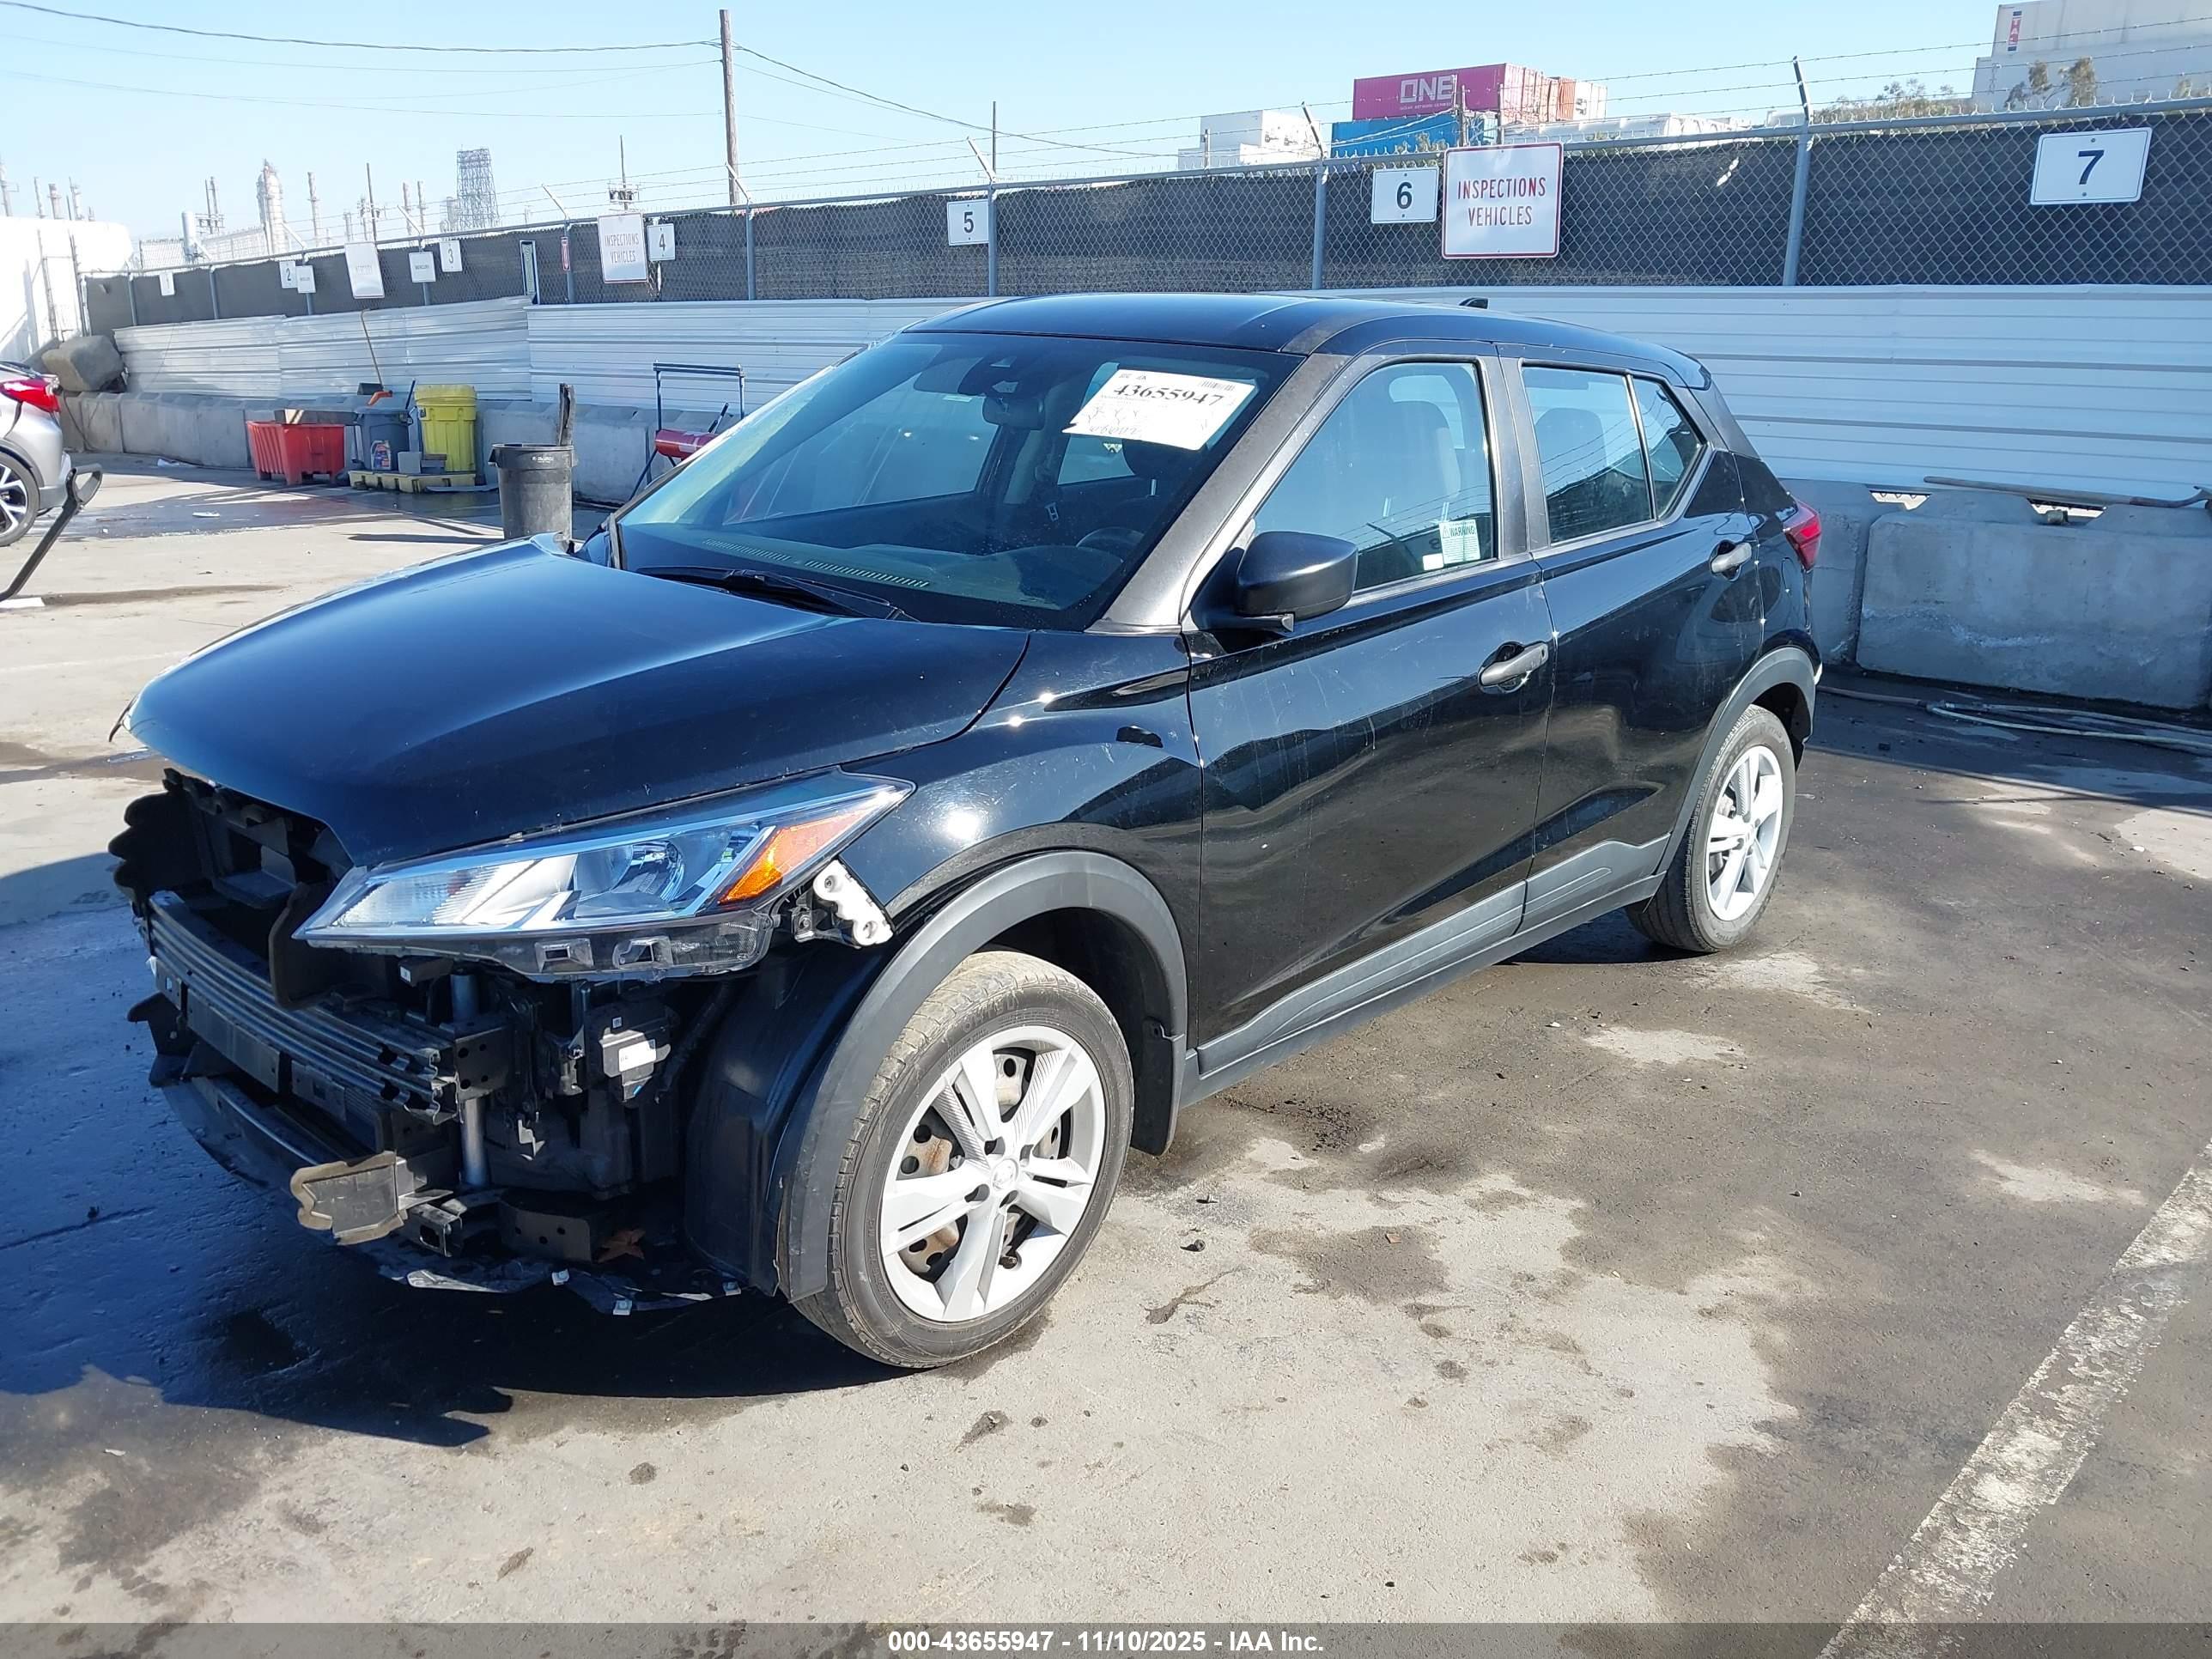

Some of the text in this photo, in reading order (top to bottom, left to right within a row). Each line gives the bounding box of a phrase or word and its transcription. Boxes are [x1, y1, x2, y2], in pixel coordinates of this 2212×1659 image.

[1401, 76, 1454, 103] ONE
[2078, 149, 2105, 185] 7
[1396, 181, 1413, 210] 6
[1457, 177, 1547, 200] INSPECTIONS
[963, 211, 974, 234] 5
[1468, 205, 1533, 227] VEHICLES
[605, 233, 640, 247] INSPECTIONS
[659, 233, 666, 252] 4
[447, 248, 454, 264] 3
[611, 250, 636, 264] VEHICLES
[286, 267, 292, 282] 2
[1114, 384, 1224, 406] 43655947
